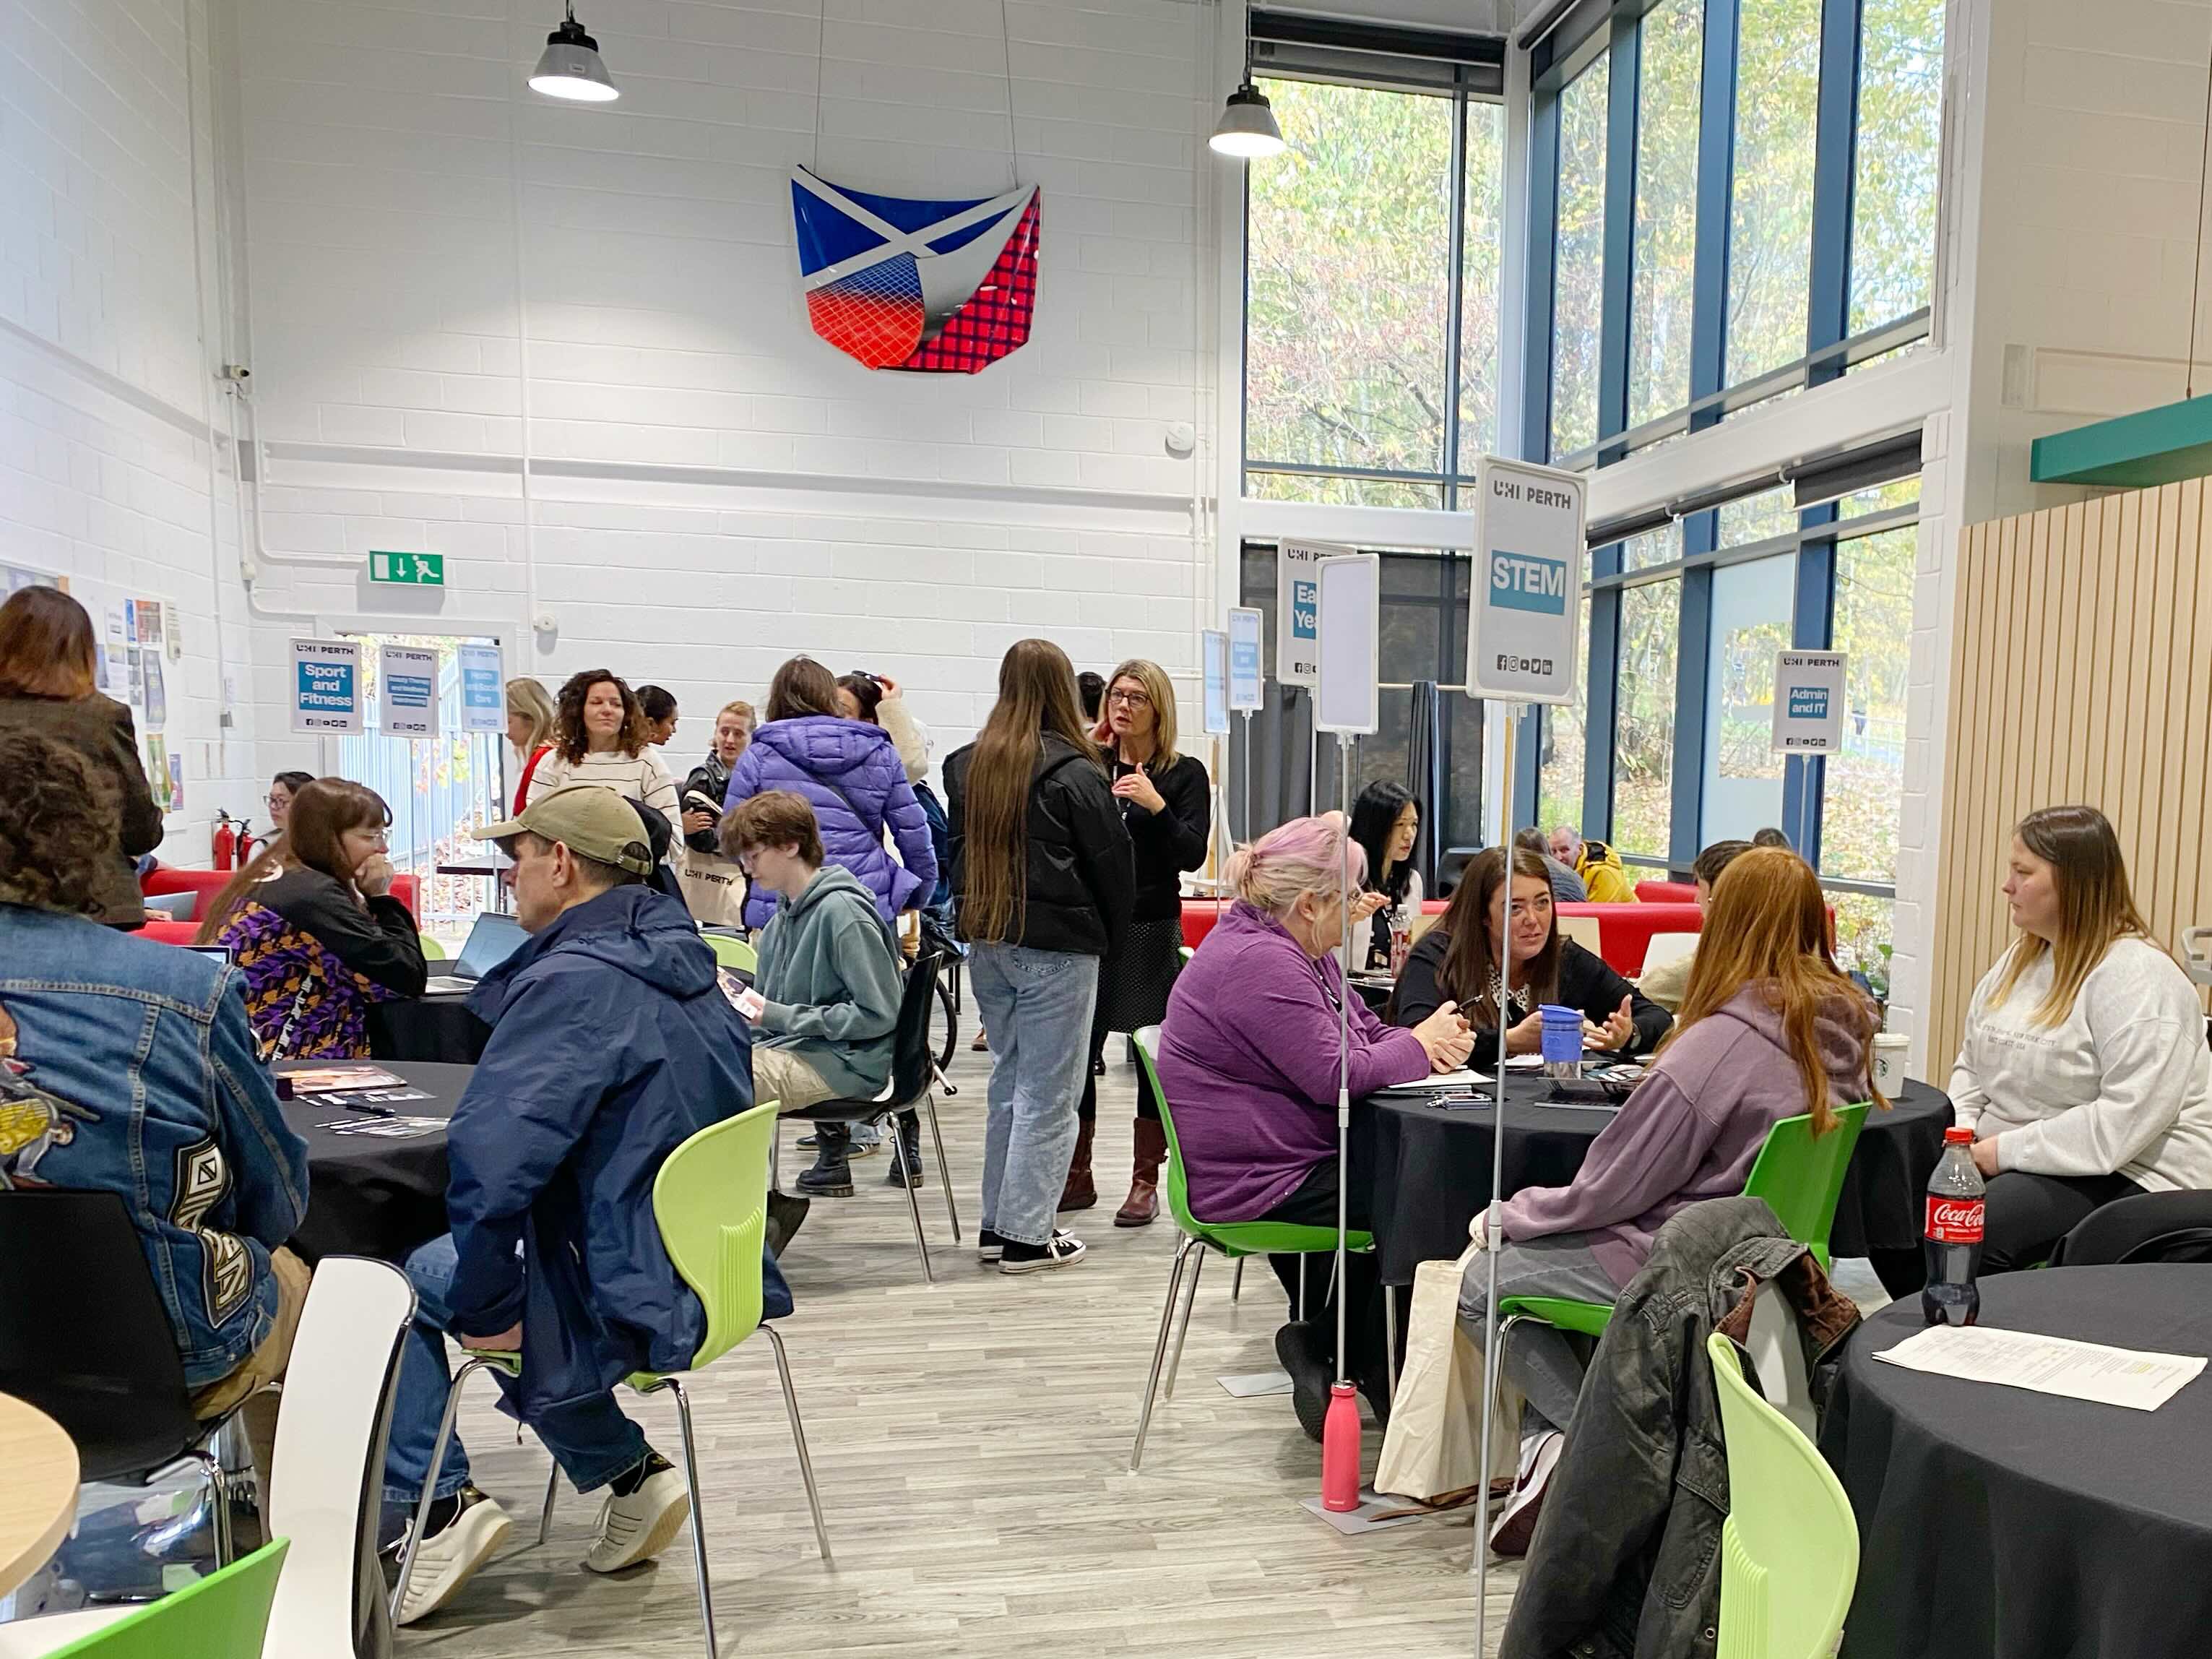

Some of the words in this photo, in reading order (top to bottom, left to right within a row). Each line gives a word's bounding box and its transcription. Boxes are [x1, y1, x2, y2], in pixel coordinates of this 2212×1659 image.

[1493, 480, 1520, 499] UHI
[1527, 486, 1571, 509] PERTH
[1288, 548, 1308, 561] UHI
[1492, 556, 1565, 597] STEM
[1297, 585, 1316, 604] Ea
[1294, 609, 1317, 629] Ye
[296, 644, 316, 653] UHI
[321, 647, 354, 655] PERTH
[406, 652, 432, 661] PERTH
[1807, 658, 1839, 667] PERTH
[305, 664, 347, 678] Sport
[312, 679, 340, 691] and
[300, 692, 353, 707] Fitness
[1791, 689, 1827, 699] Admin
[1792, 703, 1813, 713] and
[1814, 703, 1826, 714] IT
[705, 873, 733, 886] PERTH
